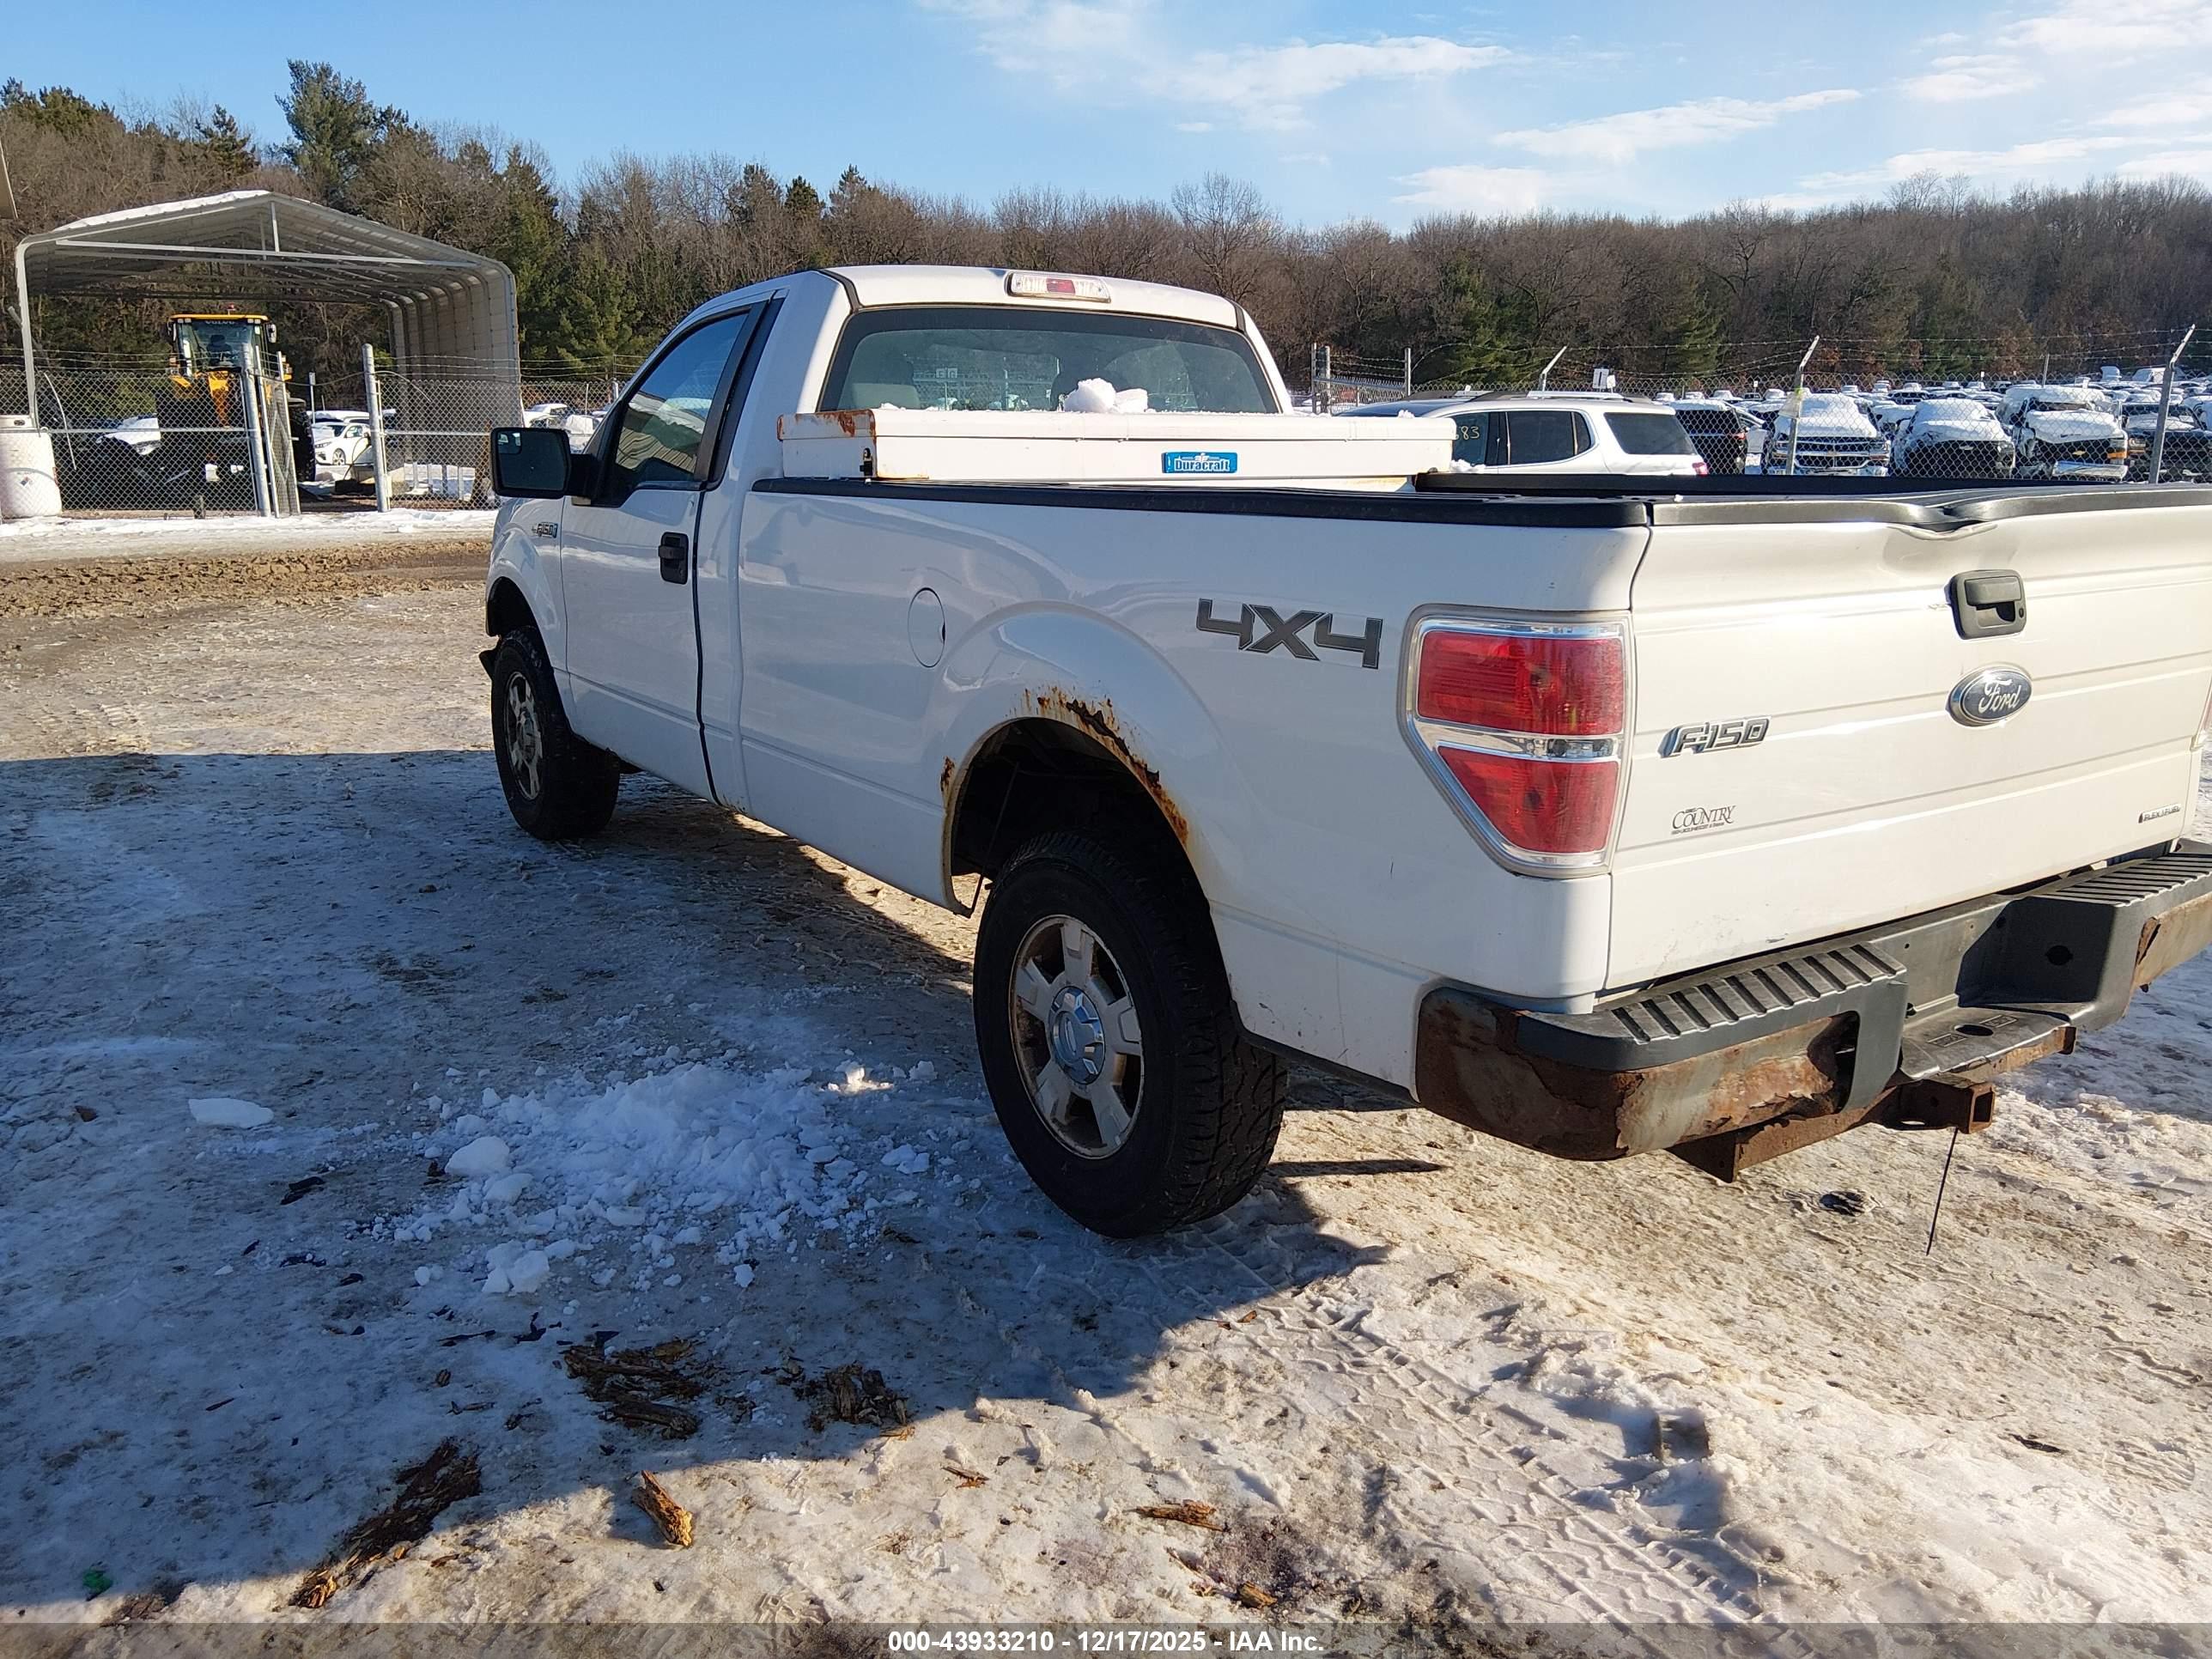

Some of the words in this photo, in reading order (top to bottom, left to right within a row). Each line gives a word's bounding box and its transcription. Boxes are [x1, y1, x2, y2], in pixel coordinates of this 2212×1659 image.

[1174, 458, 1231, 471] Duracraft
[1978, 677, 2021, 714] Ford
[1671, 718, 1770, 755] F-150
[1672, 805, 1736, 830] COUNTRY
